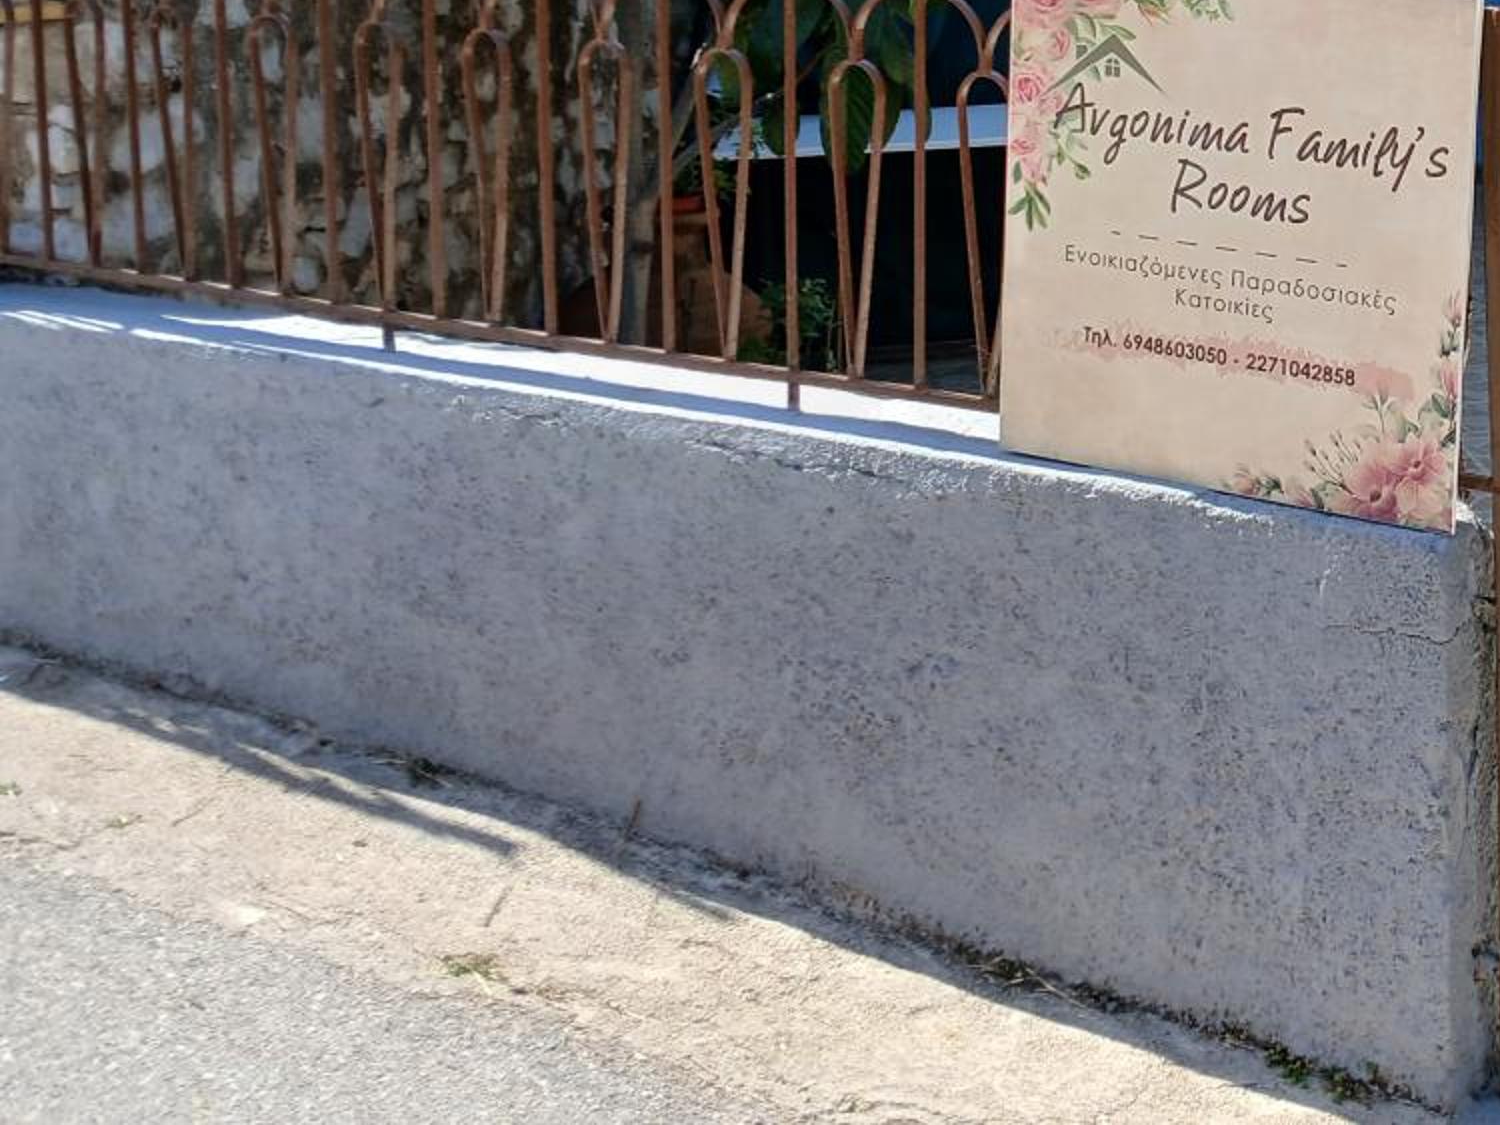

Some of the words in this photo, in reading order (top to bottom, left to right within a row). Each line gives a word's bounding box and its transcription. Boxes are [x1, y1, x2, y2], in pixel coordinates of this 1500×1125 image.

[1054, 81, 1250, 164] Avgonima
[1170, 159, 1311, 225] Rooms
[1065, 244, 1223, 289] Ενοικιαζόμενες
[1230, 269, 1397, 315] Παραδοσιακές
[1175, 288, 1274, 324] Κατοικίες
[1083, 325, 1117, 349] Τηλ.
[1123, 332, 1228, 365] 6948603050
[1245, 353, 1356, 387] 2271042858
